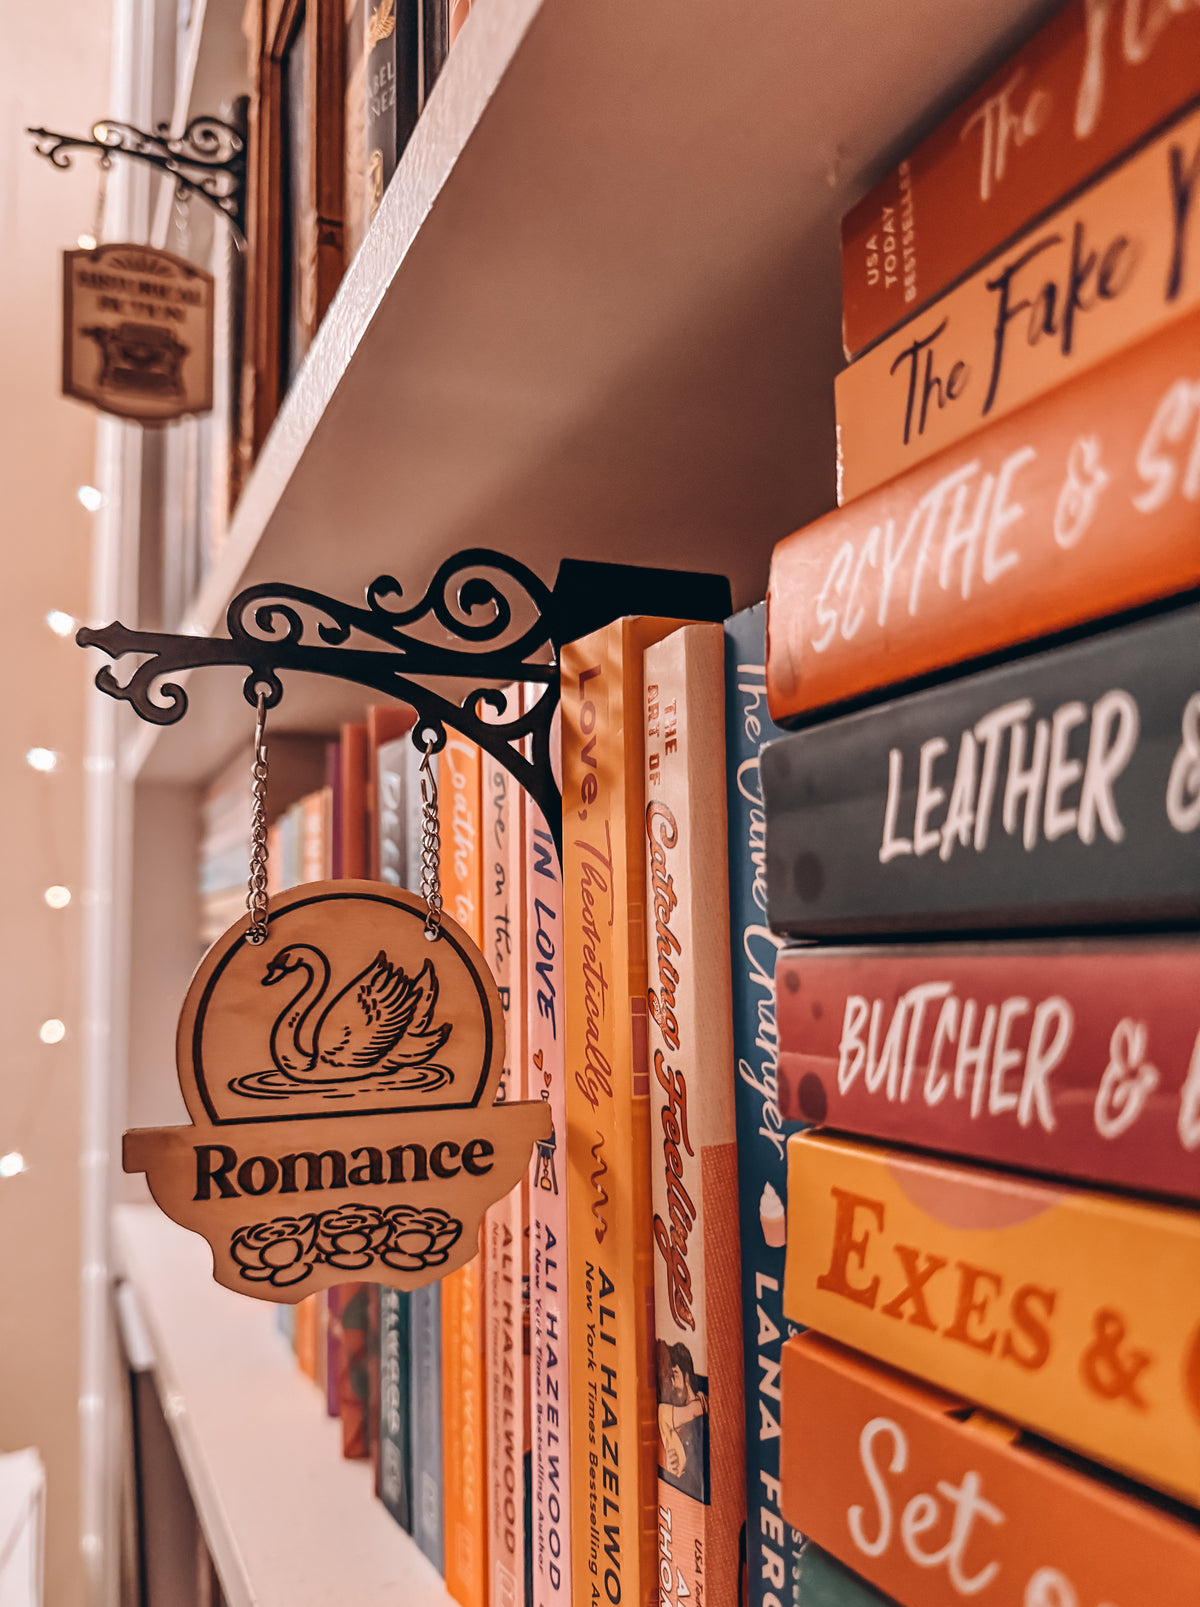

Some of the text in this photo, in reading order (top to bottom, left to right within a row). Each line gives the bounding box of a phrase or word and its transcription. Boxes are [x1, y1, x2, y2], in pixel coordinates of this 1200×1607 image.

[865, 234, 880, 286] USA
[882, 207, 898, 289] TODAY
[889, 315, 972, 446] The
[982, 220, 1142, 417] Fake
[811, 444, 1036, 654] SCYTHE
[1053, 433, 1111, 549] &
[445, 739, 476, 883] Loathe
[488, 762, 507, 851] ove
[878, 687, 1141, 864] LEATHER
[494, 862, 506, 896] on
[494, 903, 512, 974] the
[533, 828, 558, 1041] IN LOVE
[573, 664, 615, 1114] Love, Theoretically
[646, 800, 697, 1332] Catching Feelings
[837, 980, 1075, 1134] BUTCHER
[1093, 1016, 1161, 1140] &
[192, 1138, 494, 1201] Romance
[584, 1260, 596, 1314] New
[586, 1321, 597, 1372] York
[598, 1265, 617, 1347] ALI
[815, 1184, 1060, 1375] EXES
[1078, 1304, 1156, 1417] &
[501, 1223, 516, 1555] ALI HAZELWOOD
[545, 1224, 561, 1591] ALI HAZELWOOD
[587, 1381, 598, 1444] Times
[755, 1270, 782, 1441] LANA
[537, 1510, 545, 1575] Author
[588, 1453, 600, 1577] Bestselling
[693, 1537, 704, 1575] USA
[847, 1416, 1006, 1597] Set
